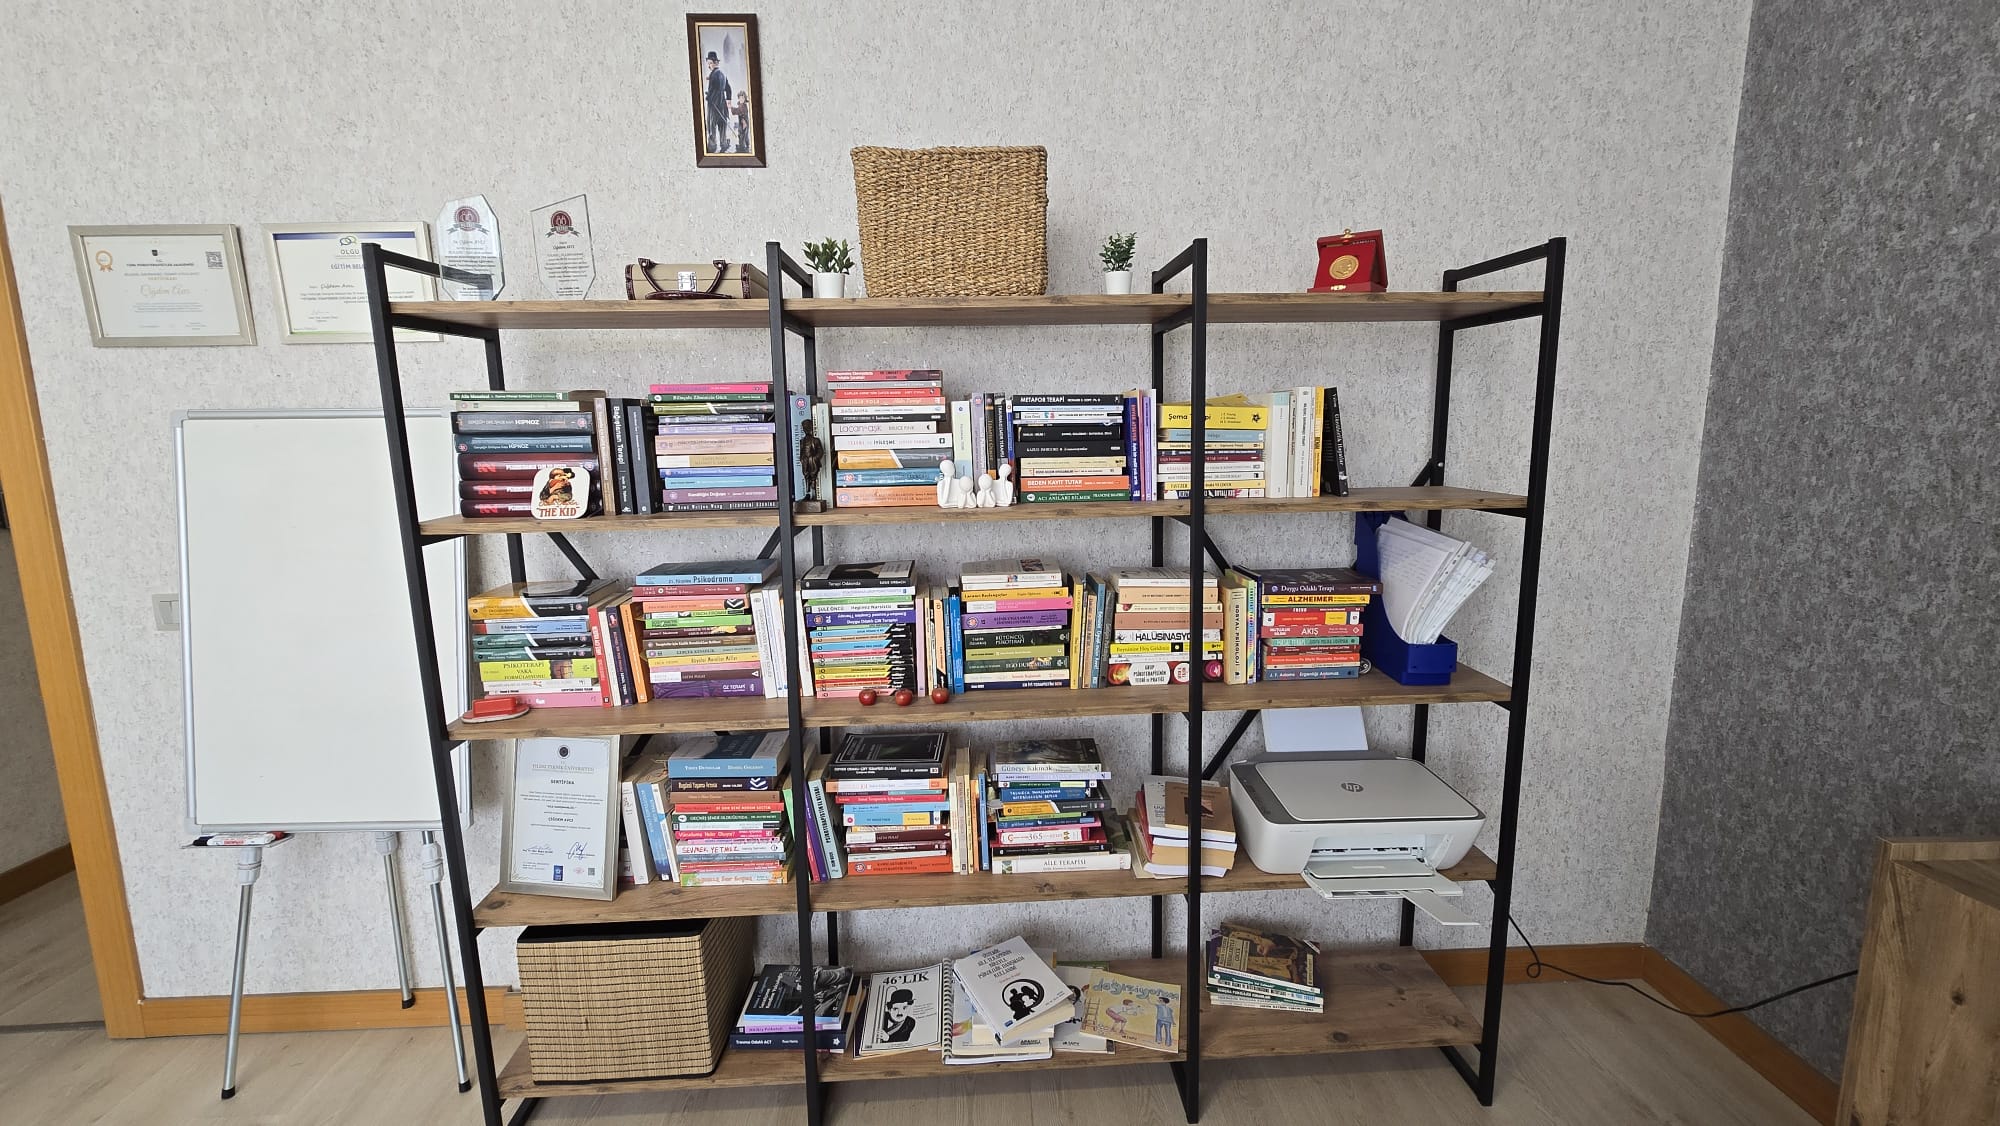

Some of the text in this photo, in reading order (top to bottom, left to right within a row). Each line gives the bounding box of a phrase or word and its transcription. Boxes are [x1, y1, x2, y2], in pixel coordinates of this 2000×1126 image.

[1047, 395, 1065, 403] TERAPİ
[1168, 413, 1188, 423] Şema
[617, 444, 625, 465] Terapi
[693, 576, 733, 584] Psikodrama
[1281, 586, 1299, 594] Duygu
[1317, 585, 1335, 593] Terapi
[1135, 631, 1191, 641] HALÜSİNASYO
[1301, 628, 1319, 636] AKIŞ
[1001, 764, 1025, 772] Güneşe
[1346, 783, 1360, 792] hp
[682, 845, 740, 854] SEVMEK YETMEZ
[1059, 858, 1086, 866] TERAPİSİ
[882, 971, 929, 985] 46'LIK
